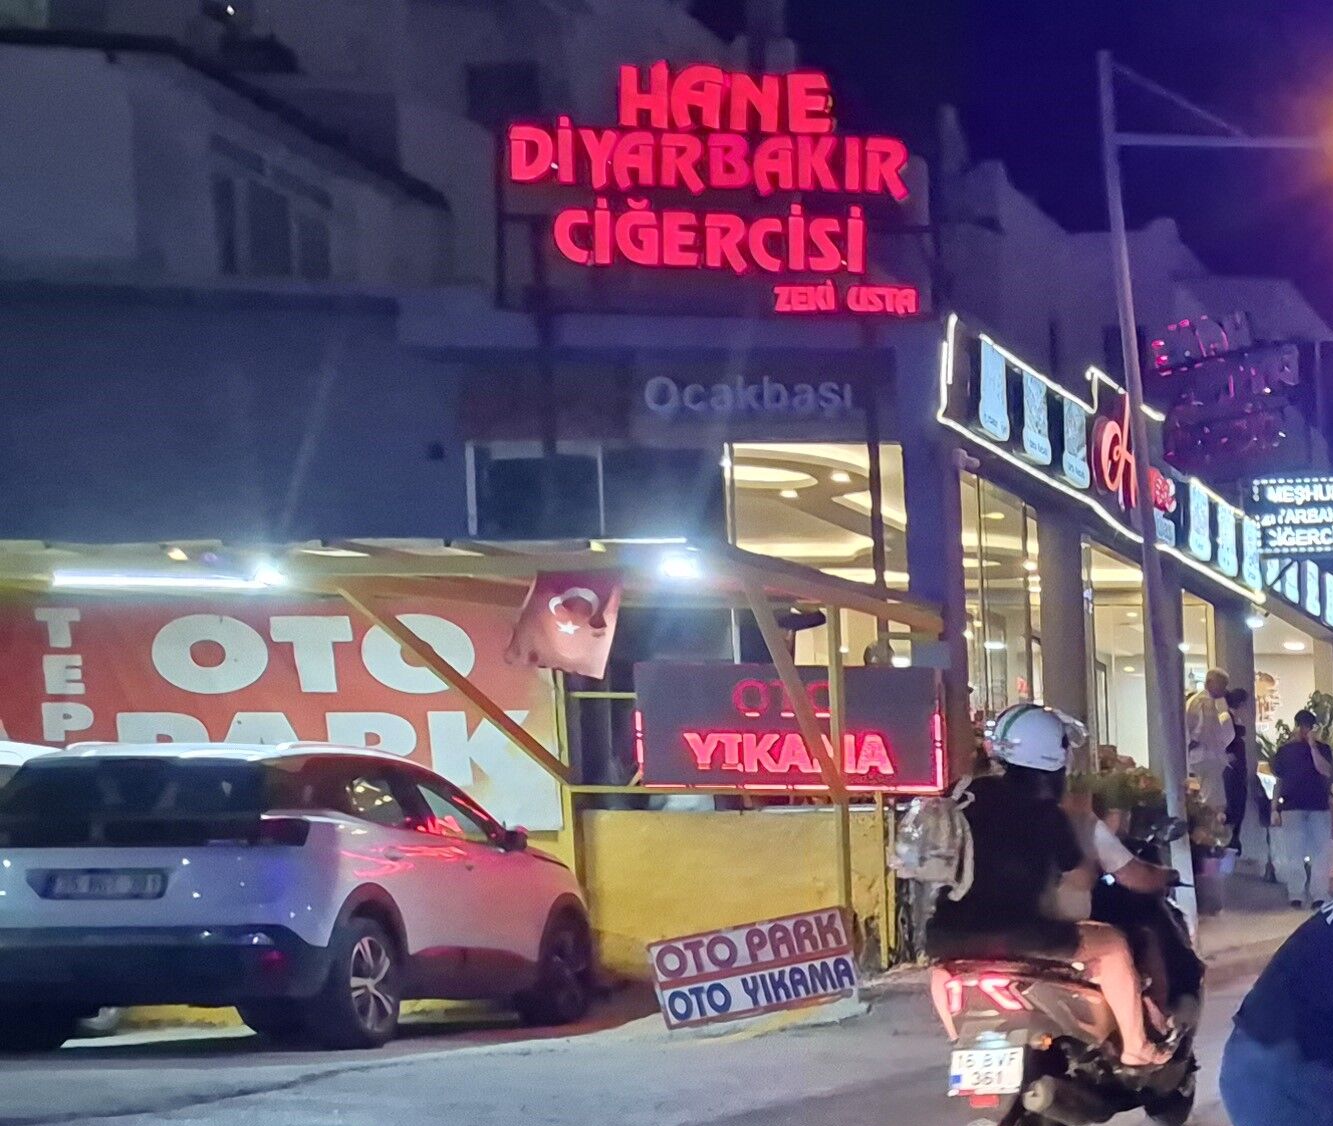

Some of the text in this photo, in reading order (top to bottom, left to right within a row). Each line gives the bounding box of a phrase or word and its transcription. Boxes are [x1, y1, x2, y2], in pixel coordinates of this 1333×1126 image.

[618, 60, 834, 134] HANE
[508, 115, 909, 200] DİYARBAKIR
[553, 197, 867, 275] CİĞERCİSİ
[846, 285, 917, 315] USTA
[150, 613, 476, 694] OTO
[655, 912, 844, 979] OTO PARK
[668, 957, 855, 1021] OTO YIKAMA
